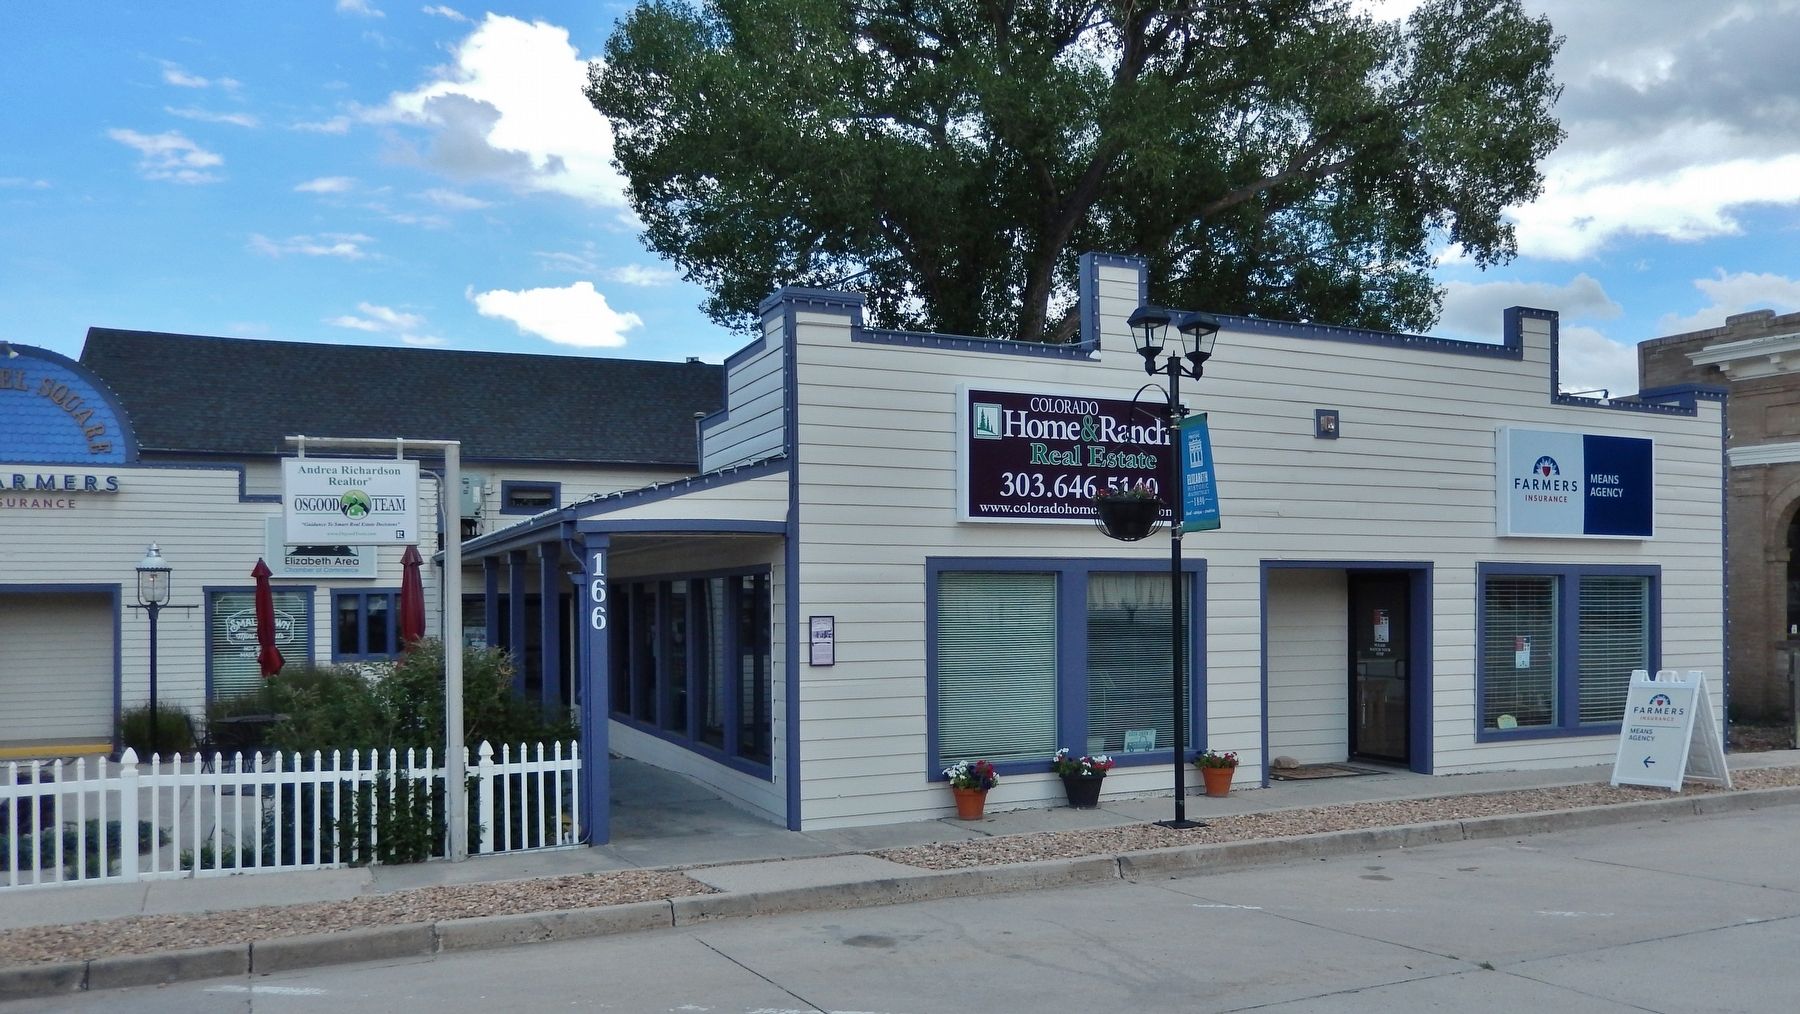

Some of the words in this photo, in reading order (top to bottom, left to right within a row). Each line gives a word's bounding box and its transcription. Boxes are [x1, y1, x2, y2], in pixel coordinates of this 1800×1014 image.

[1030, 397, 1099, 416] COLORADO
[38, 376, 112, 454] SQUARE
[1030, 443, 1082, 467] Real
[1087, 445, 1157, 469] Estate
[298, 465, 338, 475] Andrea
[341, 465, 401, 475] Richardson
[1514, 478, 1578, 492] FARMERS
[1590, 474, 1619, 485] MEANS
[1525, 494, 1568, 503] INSURANCE
[1590, 487, 1623, 498] AGENCY
[294, 497, 340, 512] OSGOOD
[374, 497, 406, 512] TEAM
[284, 557, 331, 566] Elizabeth
[334, 557, 360, 566] Area
[592, 553, 606, 629] 166
[1633, 706, 1684, 715] FARMERS
